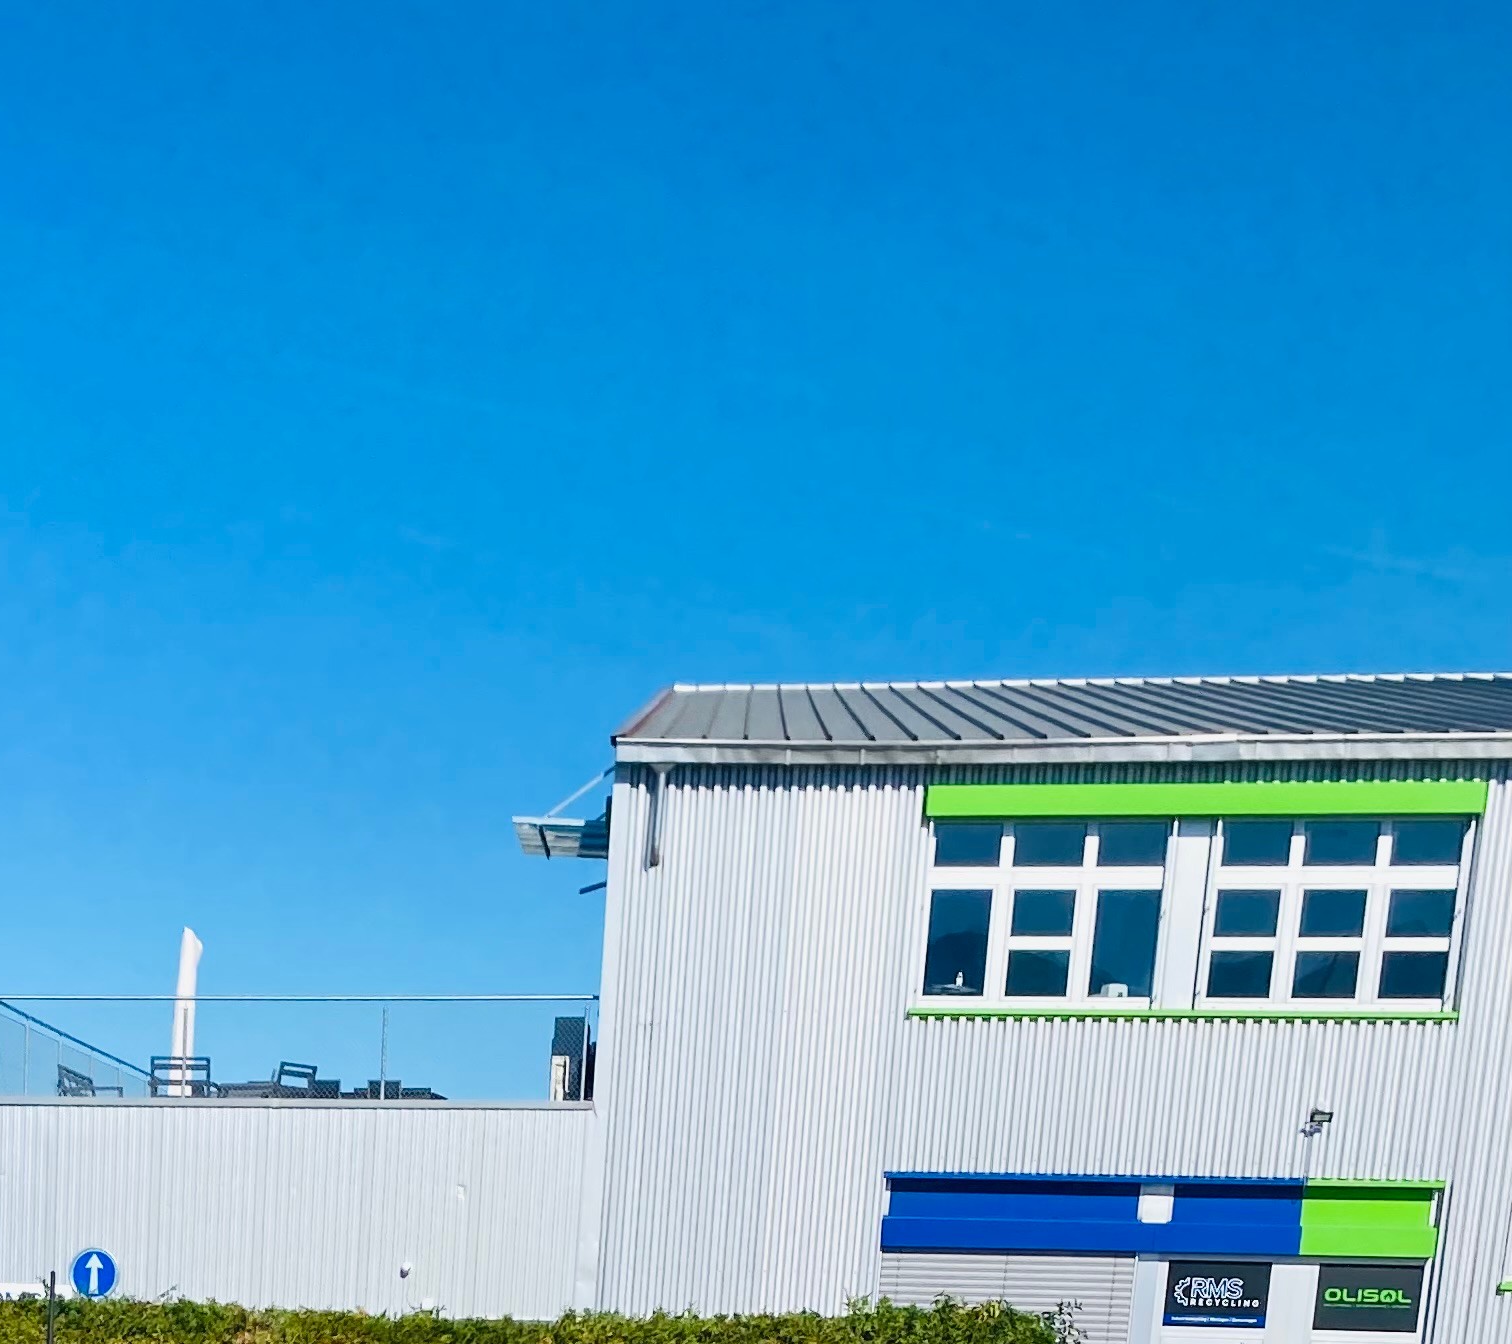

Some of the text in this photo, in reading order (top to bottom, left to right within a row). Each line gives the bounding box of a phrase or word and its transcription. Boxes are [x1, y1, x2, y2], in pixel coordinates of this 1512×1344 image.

[1190, 1277, 1245, 1299] RMS
[1324, 1287, 1412, 1303] OLISOL
[1189, 1298, 1259, 1308] RECYCLING
